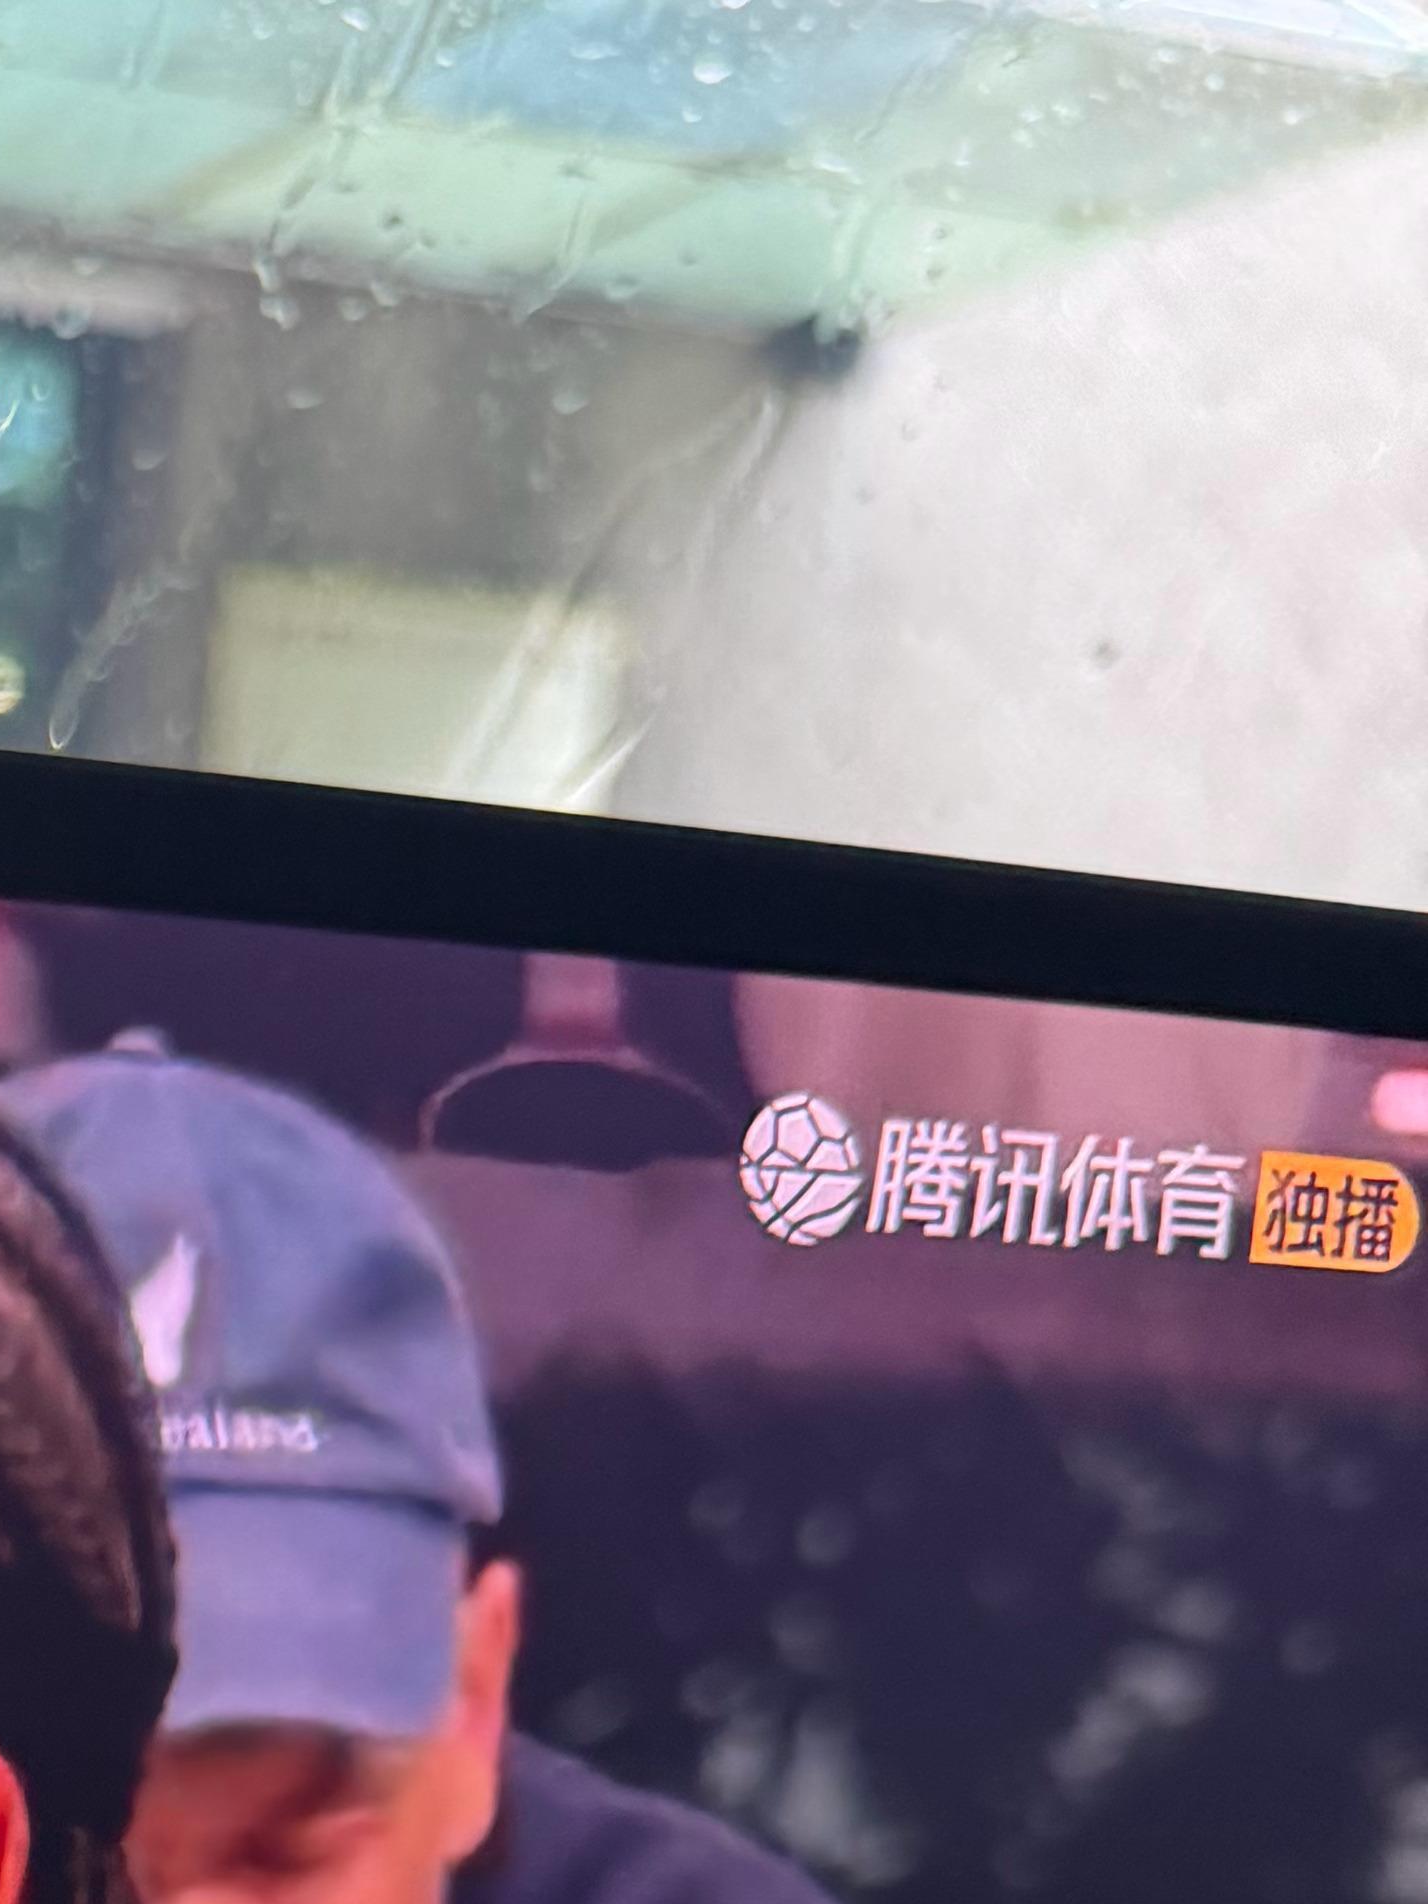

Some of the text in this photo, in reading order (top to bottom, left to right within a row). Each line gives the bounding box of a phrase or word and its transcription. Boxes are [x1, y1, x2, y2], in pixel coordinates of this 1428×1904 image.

[865, 1116, 1399, 1264] 腾讯体育 独播
